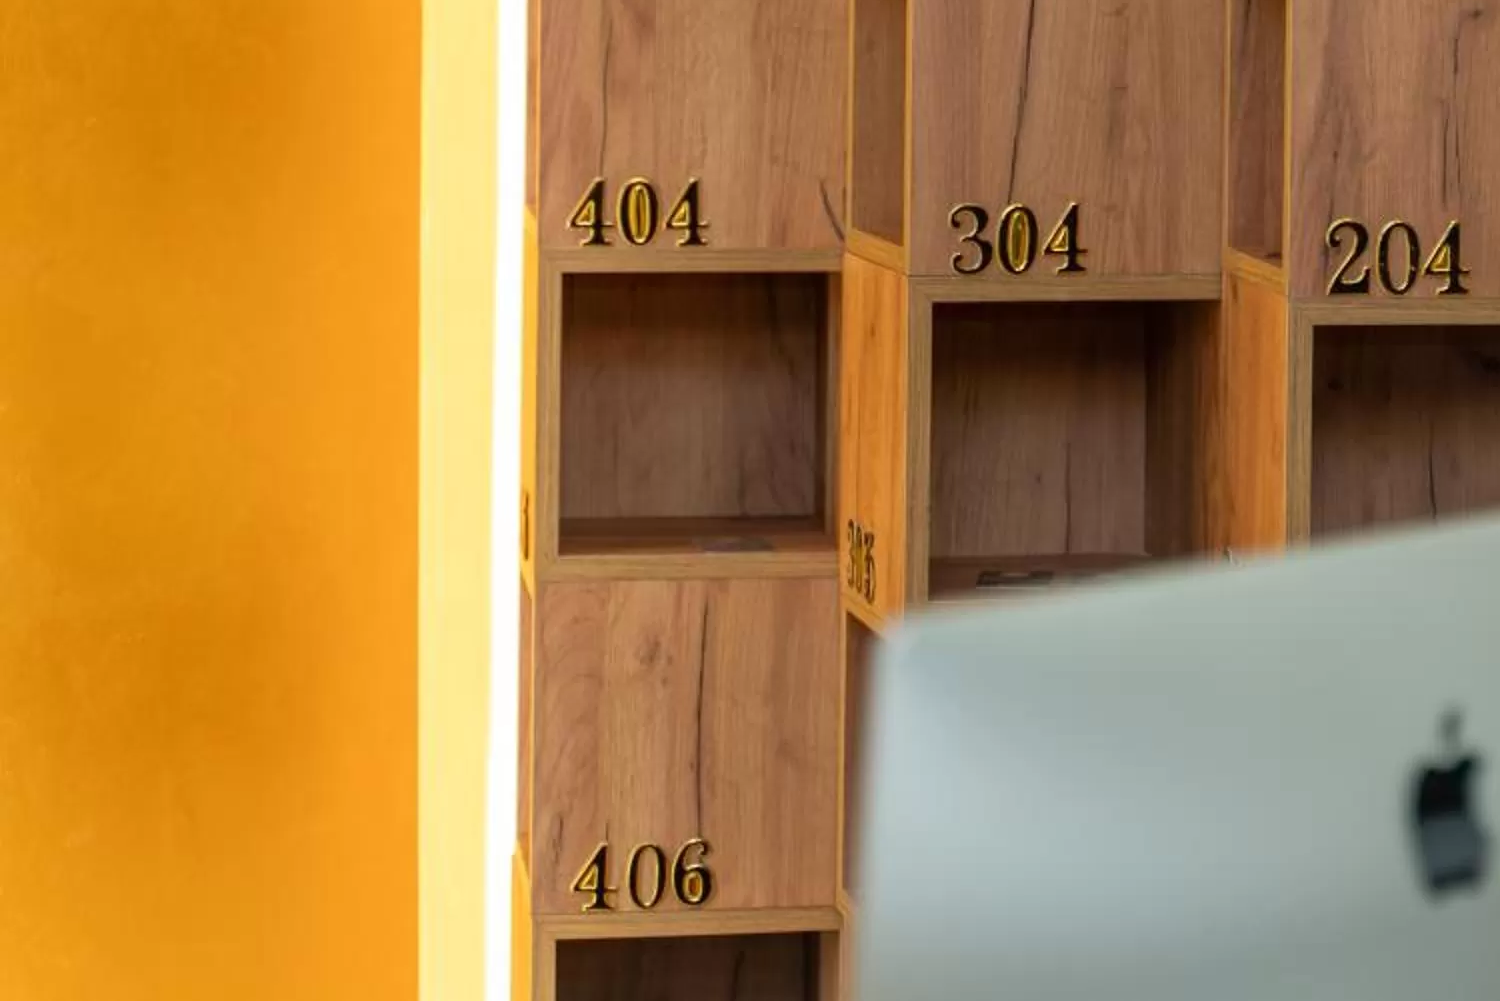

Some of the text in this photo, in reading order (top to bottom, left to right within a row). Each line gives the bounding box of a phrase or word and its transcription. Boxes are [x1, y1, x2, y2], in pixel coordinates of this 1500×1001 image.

[566, 176, 708, 248] 404
[948, 201, 1088, 276] 304
[1324, 216, 1471, 298] 204
[572, 838, 714, 913] 406
